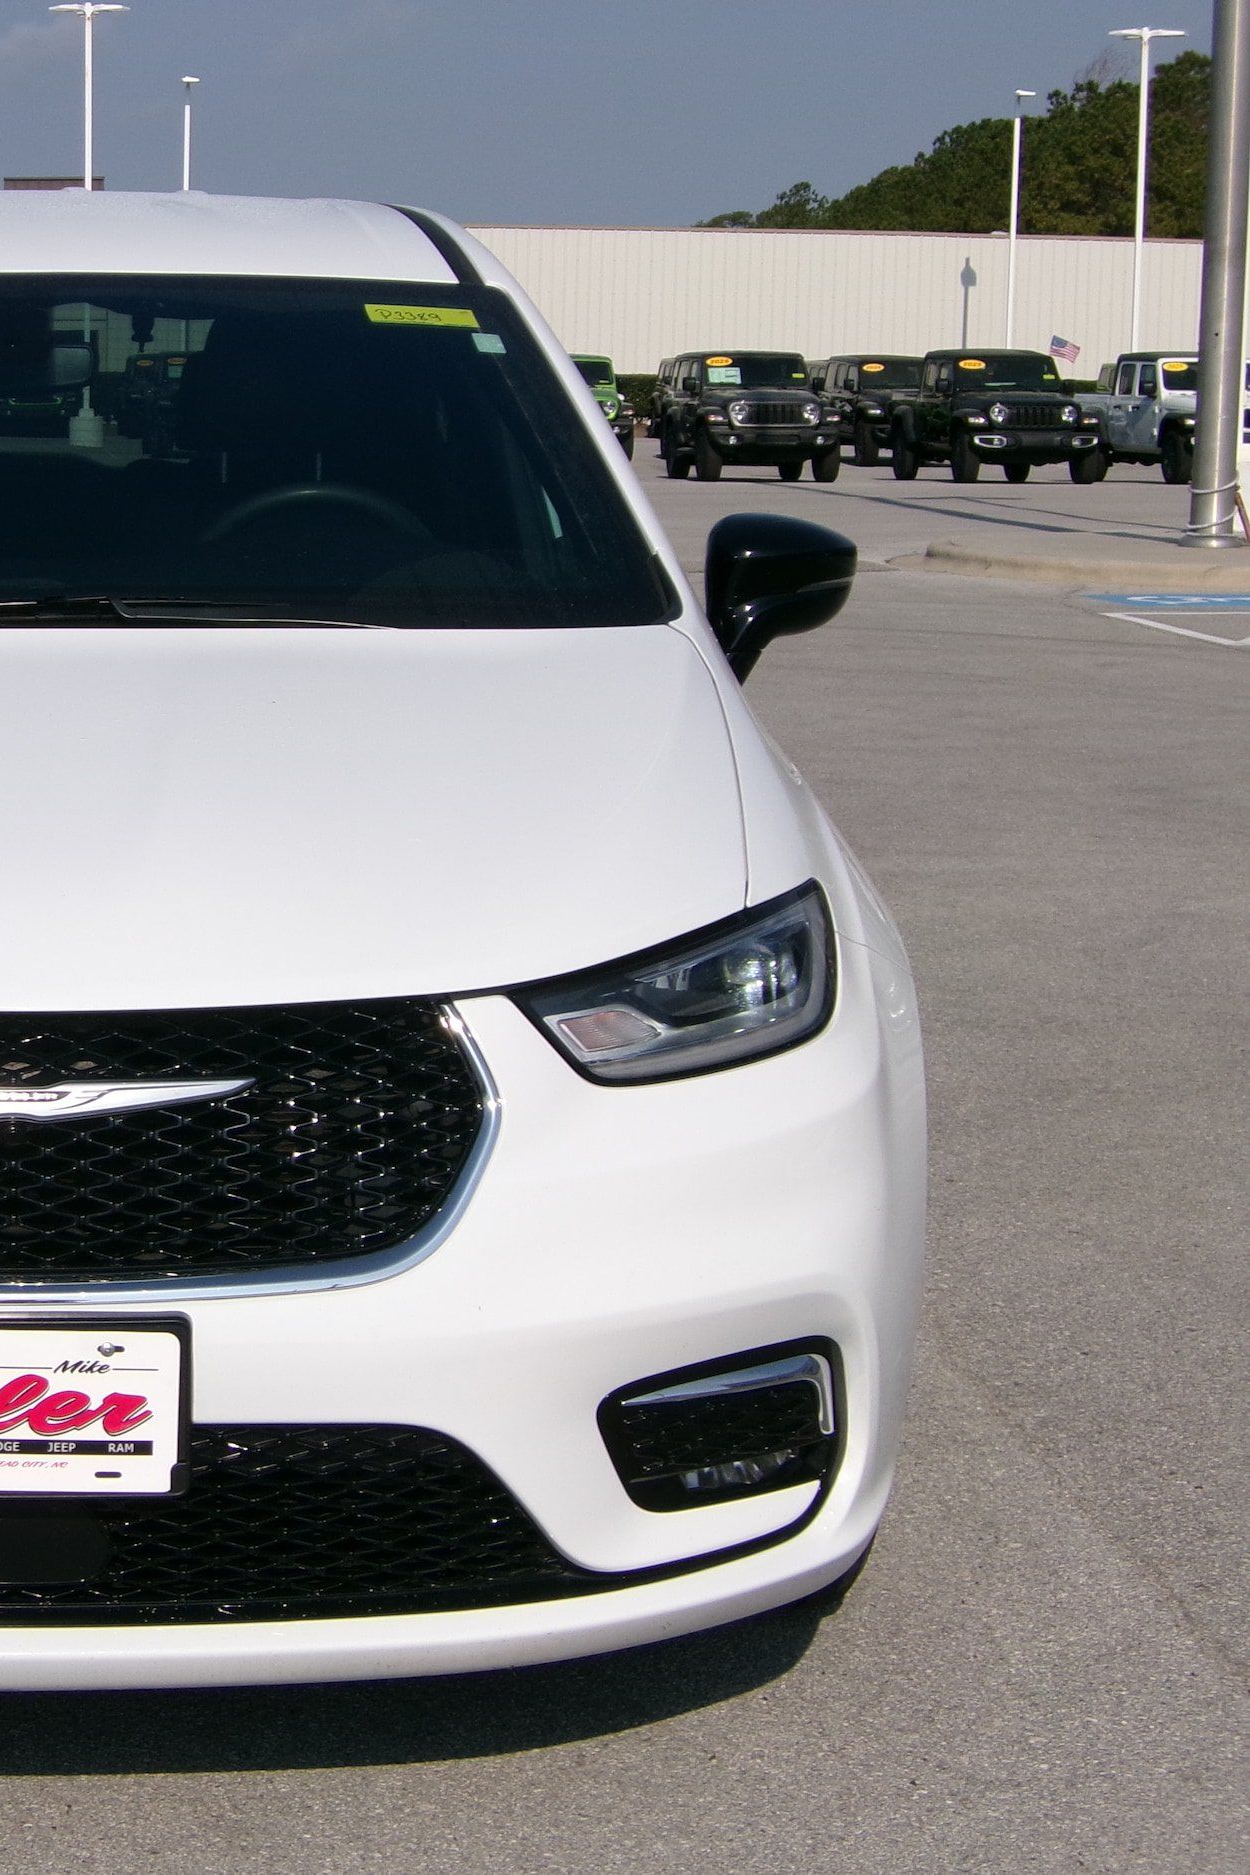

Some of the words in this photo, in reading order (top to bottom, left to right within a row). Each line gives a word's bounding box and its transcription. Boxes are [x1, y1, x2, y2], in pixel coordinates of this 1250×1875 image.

[53, 1360, 111, 1375] Mike
[47, 1442, 77, 1453] JEEP
[108, 1443, 135, 1453] RAM
